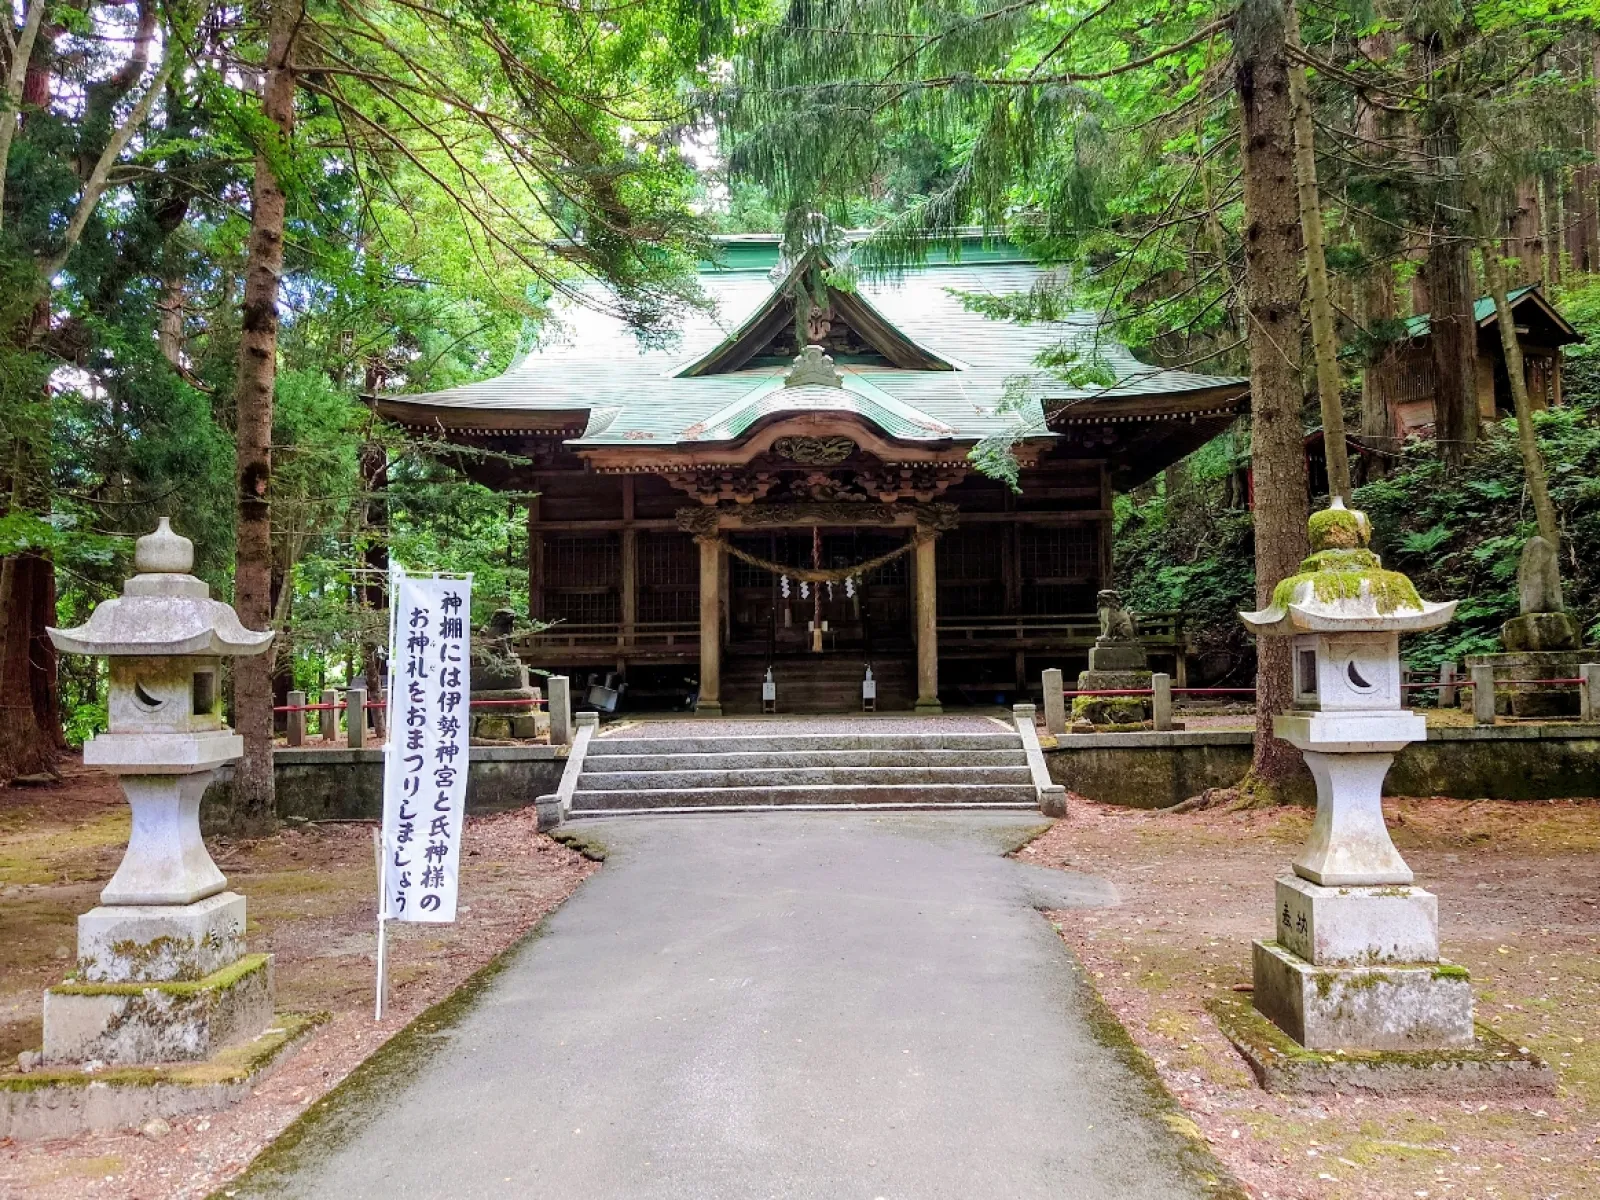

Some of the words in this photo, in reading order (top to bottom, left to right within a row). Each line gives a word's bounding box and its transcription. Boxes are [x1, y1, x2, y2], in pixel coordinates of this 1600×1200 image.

[420, 591, 463, 911] 神棚には伊勢神宮と氏神様の
